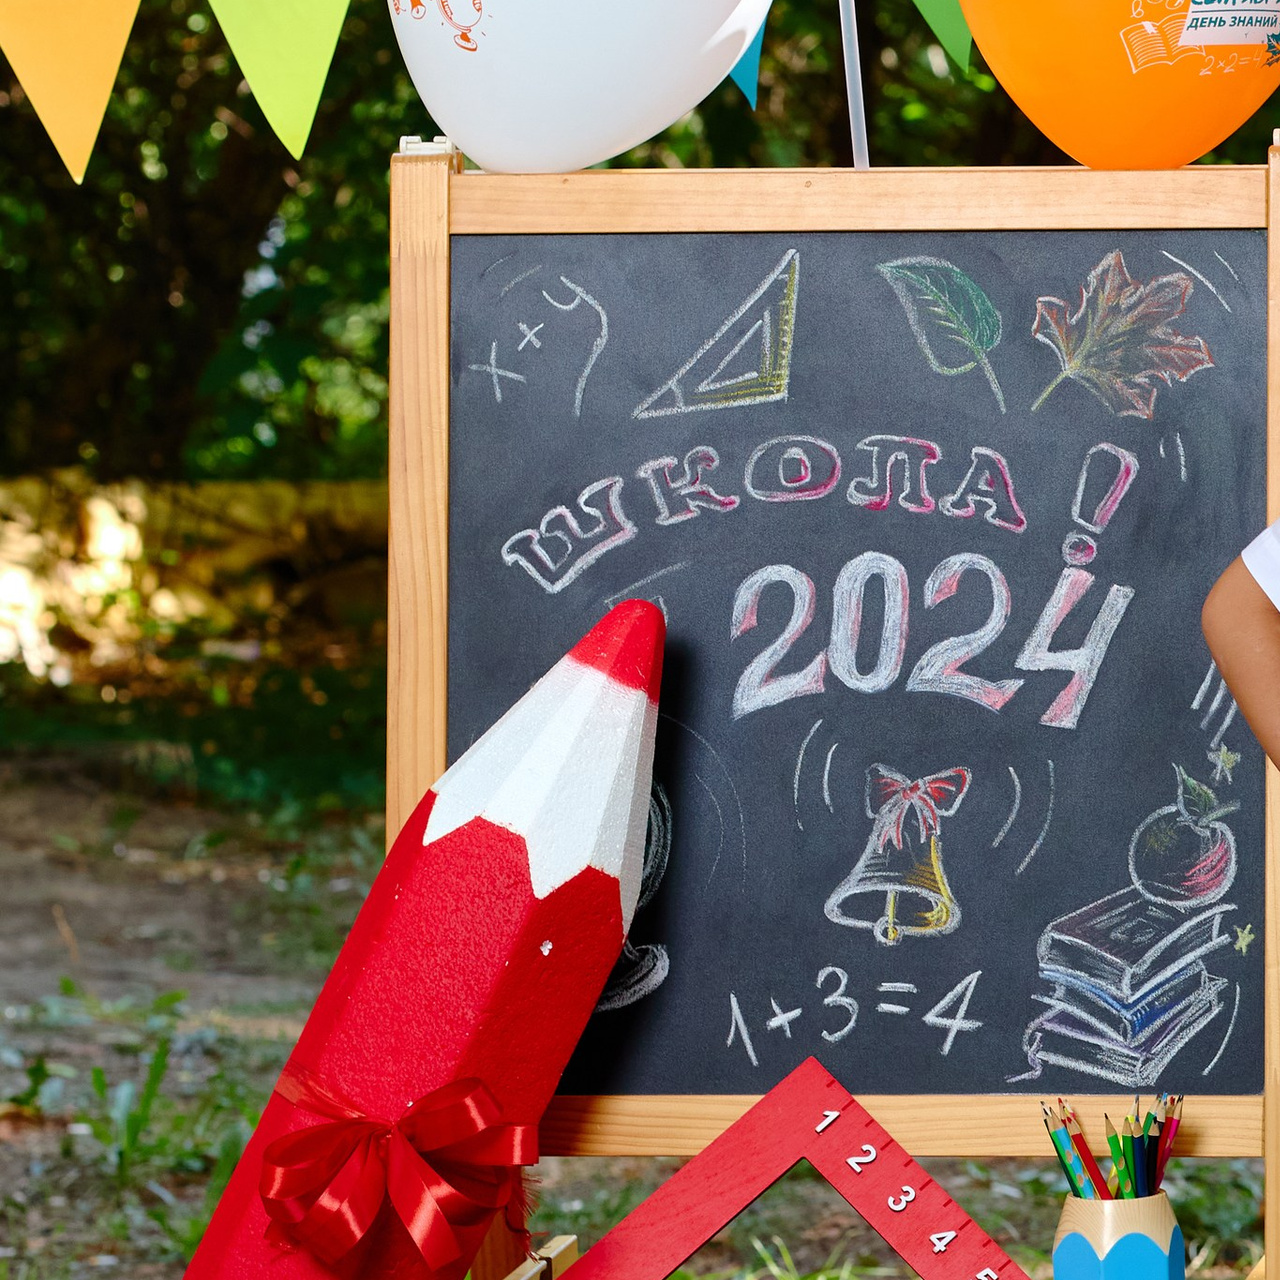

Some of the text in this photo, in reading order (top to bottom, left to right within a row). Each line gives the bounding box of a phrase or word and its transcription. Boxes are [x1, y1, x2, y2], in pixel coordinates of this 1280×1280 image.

[1186, 13, 1279, 31] ДЕНЬ ЗНАНИЙ
[729, 549, 1135, 731] 2024
[814, 1109, 842, 1135] 1
[845, 1144, 878, 1175] 2
[887, 1185, 917, 1213] 3
[928, 1229, 959, 1255] 4
